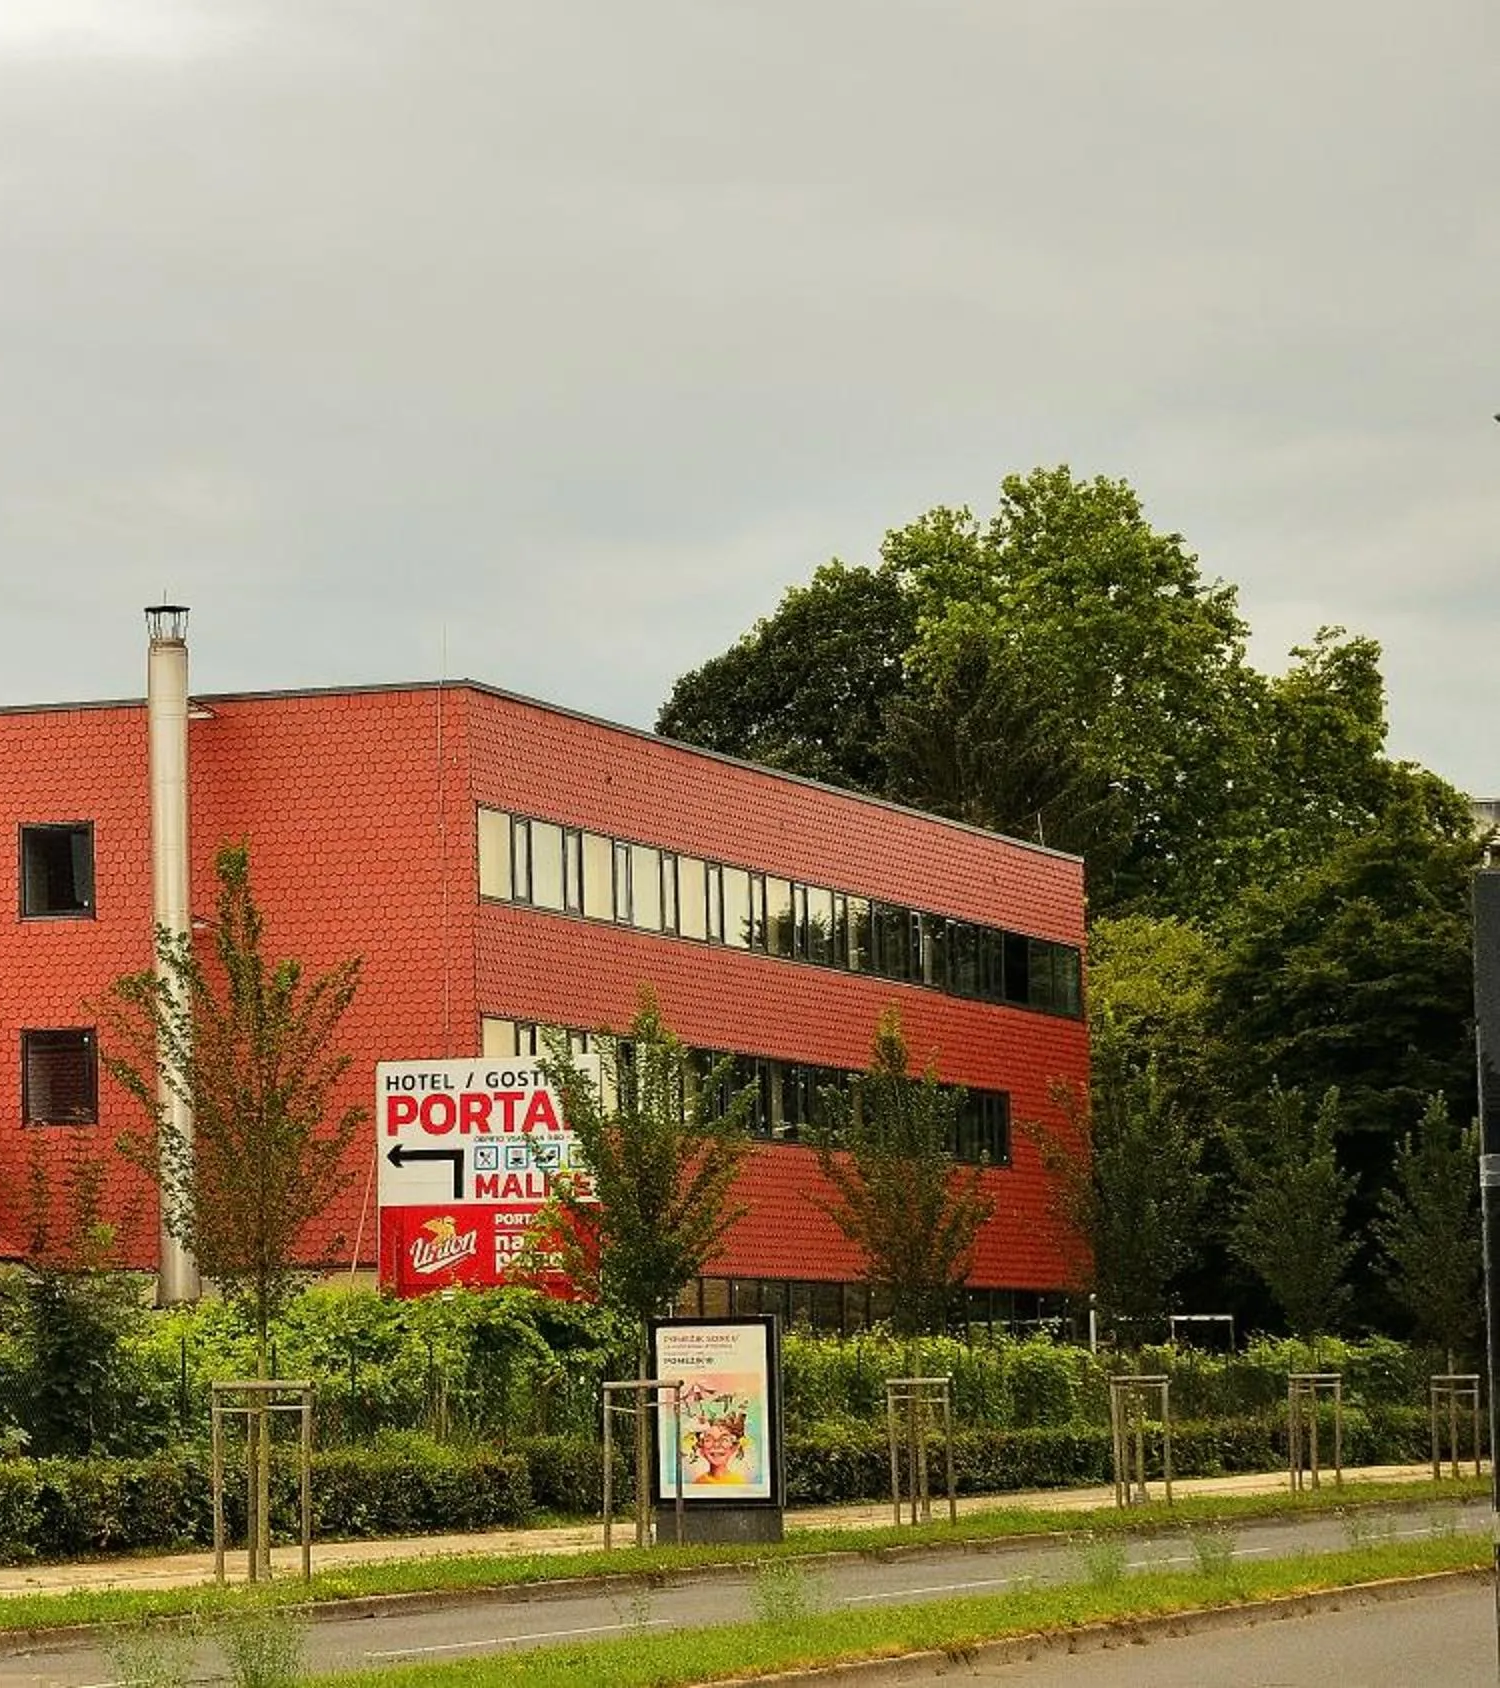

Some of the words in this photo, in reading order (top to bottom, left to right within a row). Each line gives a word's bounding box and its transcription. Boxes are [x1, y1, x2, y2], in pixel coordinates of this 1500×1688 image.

[386, 1074, 454, 1091] HOTEL
[475, 1172, 592, 1198] MALIE
[494, 1213, 540, 1225] PORT
[409, 1229, 477, 1269] Union
